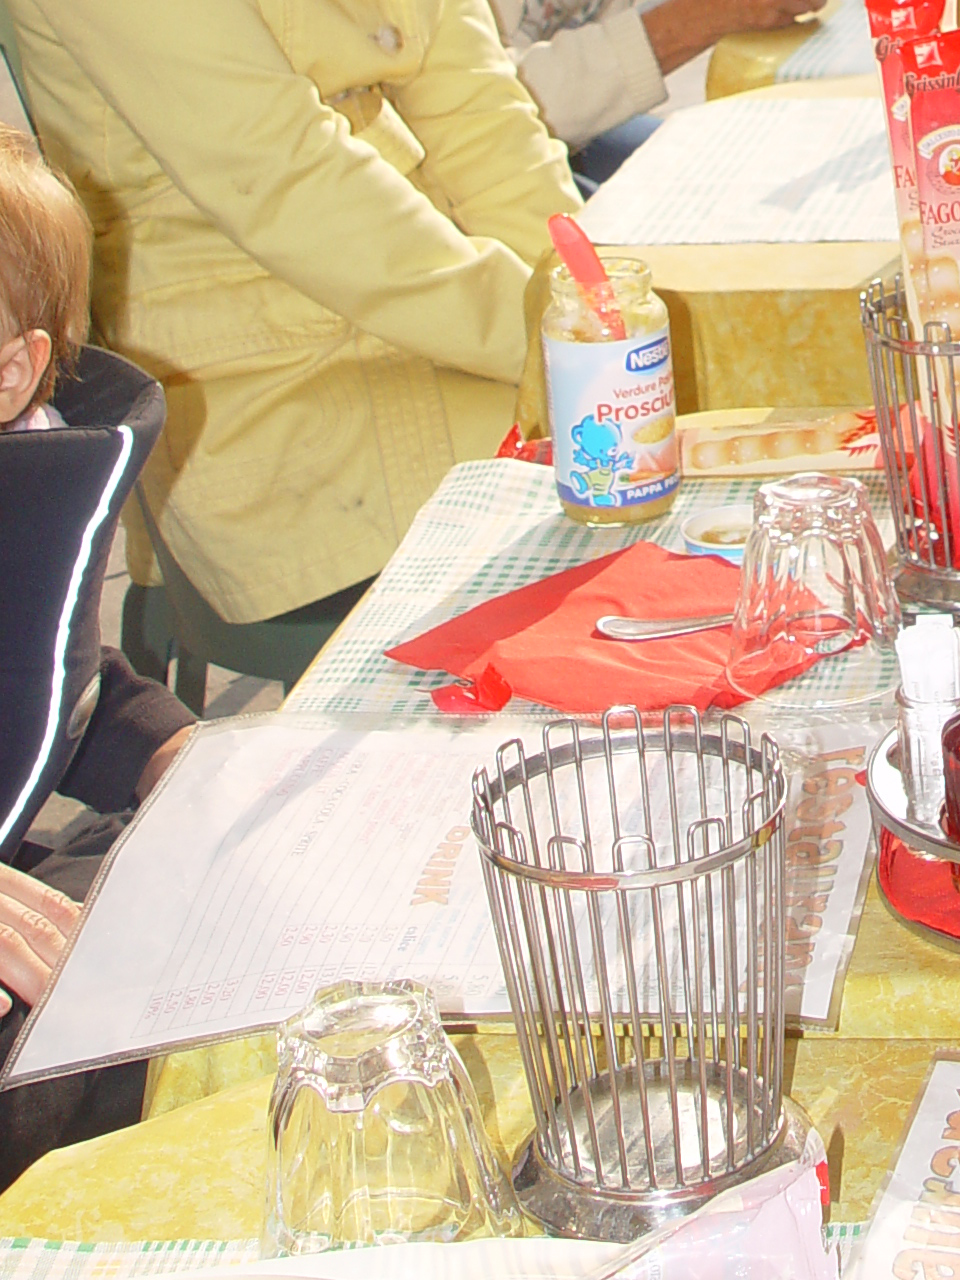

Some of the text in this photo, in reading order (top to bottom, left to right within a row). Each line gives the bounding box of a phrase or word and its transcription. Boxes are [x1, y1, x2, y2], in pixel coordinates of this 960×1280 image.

[613, 382, 657, 400] Verdure
[627, 485, 664, 500] PAPPA
[410, 826, 471, 906] DRINK
[397, 926, 420, 952] calice
[318, 967, 336, 986] 13,0
